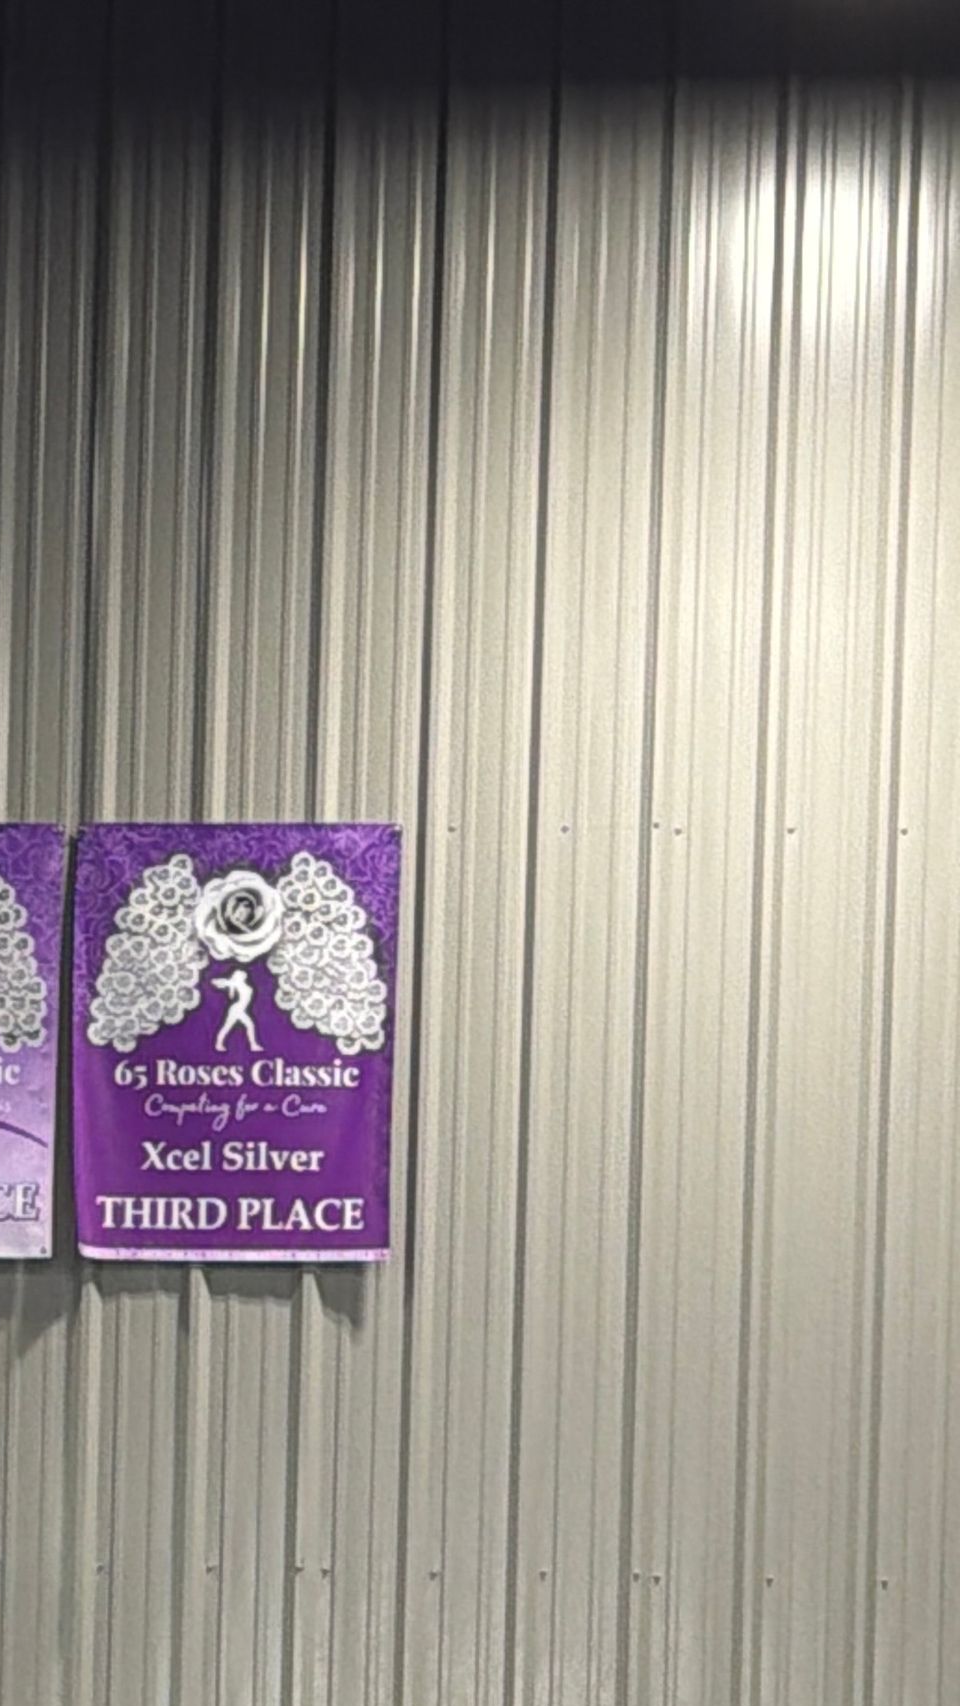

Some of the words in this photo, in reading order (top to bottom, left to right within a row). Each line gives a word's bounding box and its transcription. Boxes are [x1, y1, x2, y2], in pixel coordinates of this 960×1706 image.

[114, 1059, 148, 1089] 65
[156, 1059, 244, 1086] Roses
[251, 1058, 360, 1087] Classic
[143, 1092, 230, 1131] Competing
[234, 1093, 258, 1121] for
[263, 1102, 278, 1112] a
[281, 1093, 327, 1117] Cure
[140, 1141, 212, 1170] Xcel
[222, 1141, 325, 1171] Silver
[96, 1196, 227, 1230] THIRD
[237, 1198, 364, 1231] PLACE
